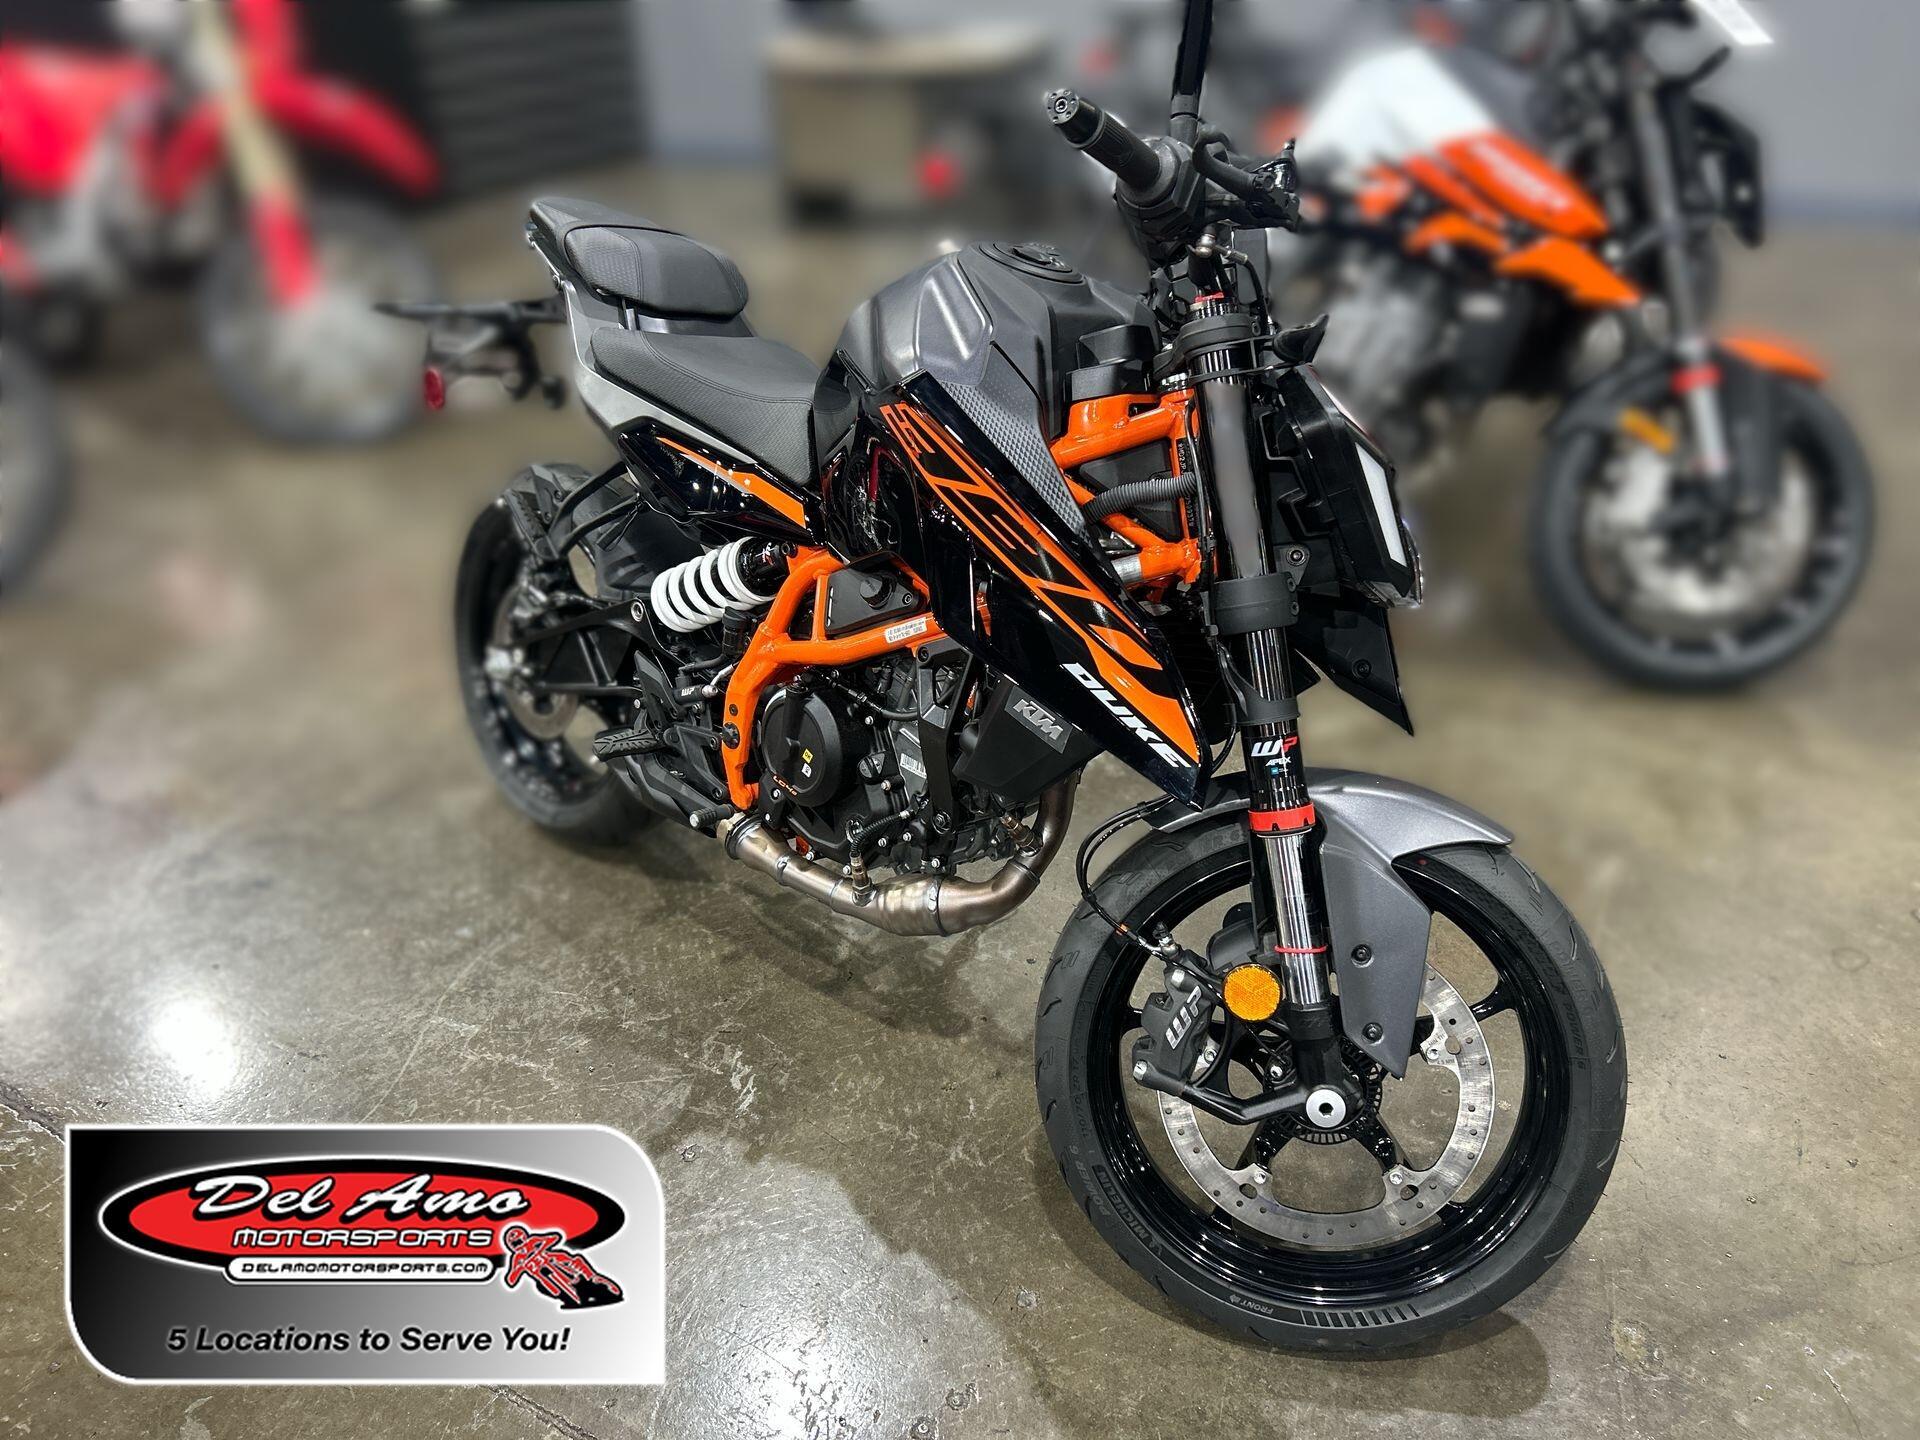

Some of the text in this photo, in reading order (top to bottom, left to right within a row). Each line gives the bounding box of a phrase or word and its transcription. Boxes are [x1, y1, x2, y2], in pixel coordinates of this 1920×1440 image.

[1013, 699, 1064, 741] KTM
[1061, 662, 1191, 768] DUKE
[1251, 736, 1298, 757] WP
[1165, 985, 1202, 1050] WP
[1073, 1160, 1112, 1216] POWER
[1097, 1171, 1150, 1239] MICHELIN
[1239, 1298, 1275, 1315] FRONT
